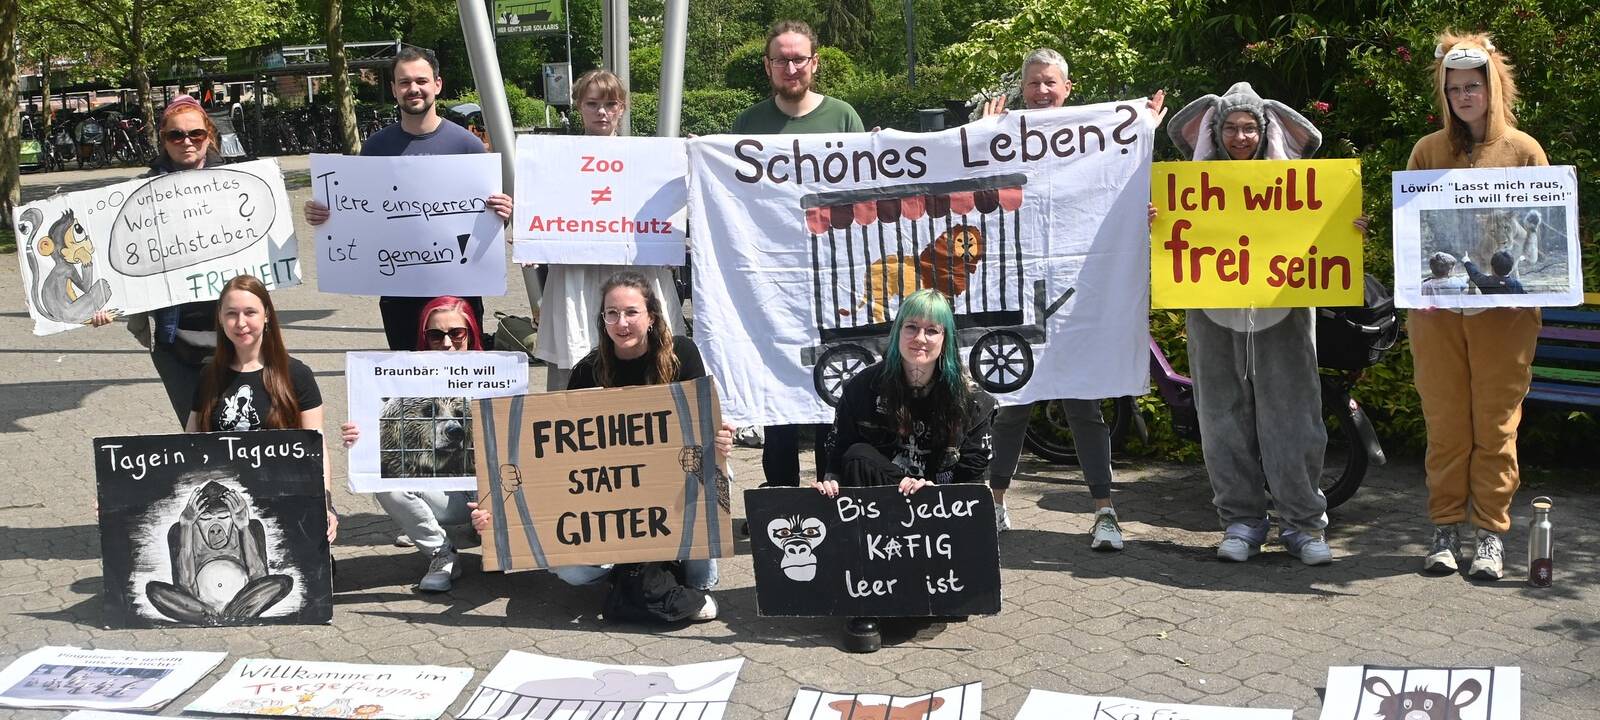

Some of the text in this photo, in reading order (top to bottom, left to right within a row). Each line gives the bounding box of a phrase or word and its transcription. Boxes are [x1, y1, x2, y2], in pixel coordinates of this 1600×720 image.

[734, 104, 1138, 184] Schönes Leben?
[581, 156, 624, 172] Zoo
[137, 177, 240, 206] unbekanntes
[317, 171, 486, 221] Tiere einsperren
[1167, 167, 1323, 211] Ich will
[1400, 180, 1563, 194] Löwin: "Lasst mich raus,
[1454, 192, 1572, 204] ich will frei sein!"
[124, 211, 168, 233] Wort
[183, 202, 213, 220] mit
[528, 216, 673, 234] Artenschutz
[126, 224, 259, 265] 8 Buchstaben
[327, 234, 471, 276] ist gemein!
[1164, 219, 1351, 290] frei sein
[374, 366, 496, 376] Braunbär: "Ich will
[448, 379, 517, 389] hier raus!"
[532, 410, 673, 459] FREIHEIT
[101, 444, 185, 480] Tagein
[218, 436, 321, 469] Tagaus...
[568, 463, 647, 495] STATT
[836, 490, 980, 527] Bis jeder
[556, 506, 672, 546] GITTER
[845, 568, 965, 598] leer ist
[240, 664, 448, 682] Willkommen im
